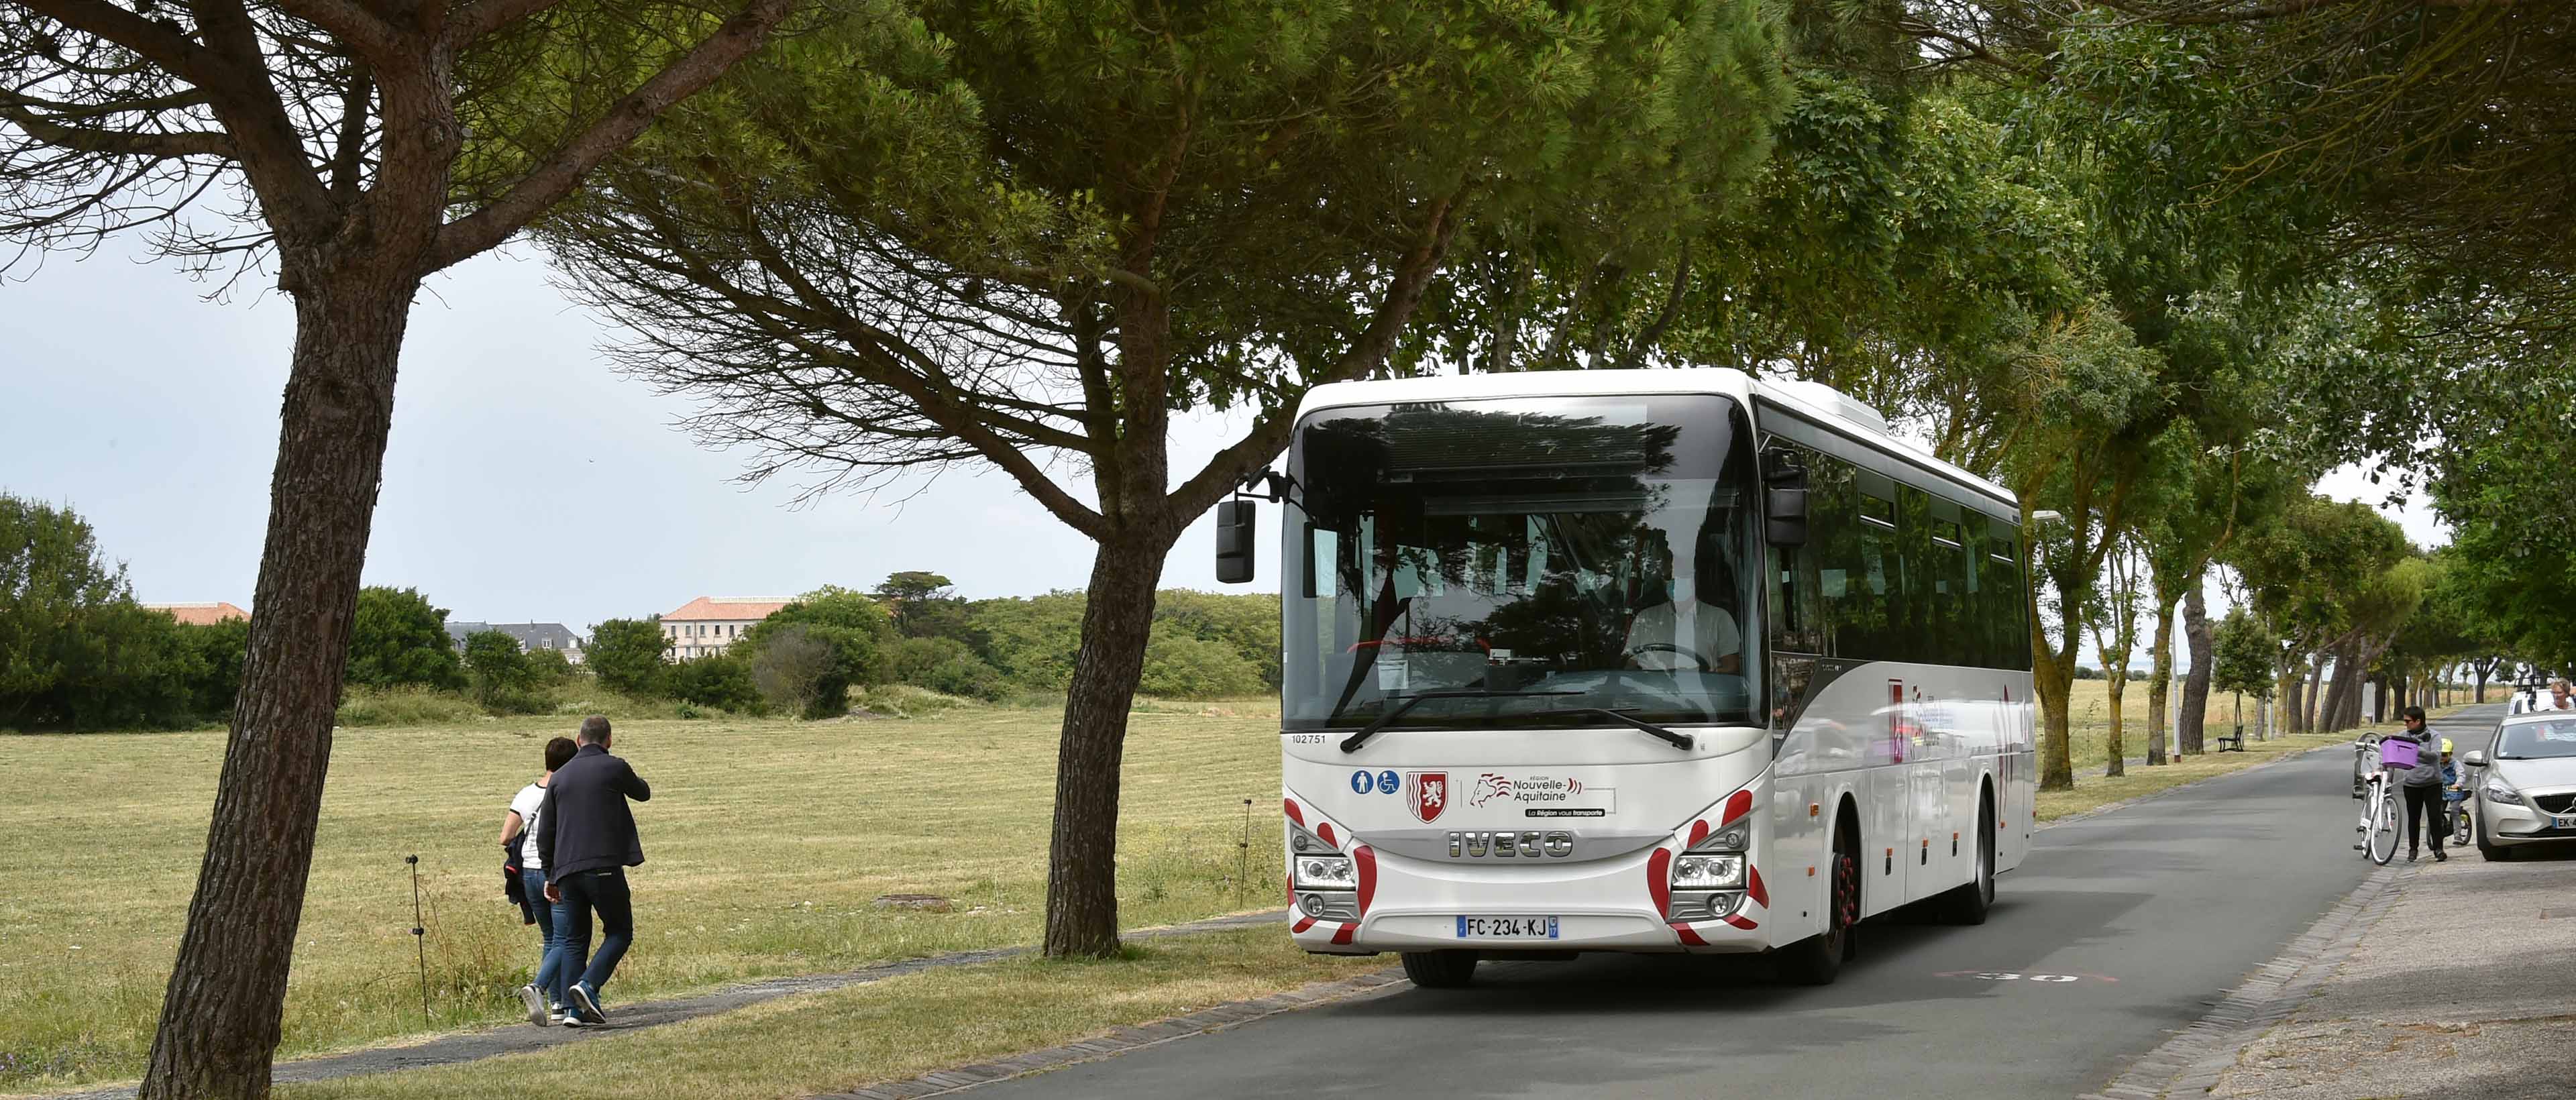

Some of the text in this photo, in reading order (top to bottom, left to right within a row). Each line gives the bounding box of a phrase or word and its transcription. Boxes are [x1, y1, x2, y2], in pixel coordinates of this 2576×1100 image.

[1292, 734, 1326, 744] 102751
[1513, 780, 1566, 790] Nouvelle-
[1514, 791, 1566, 804] Aquitaine
[1536, 808, 1557, 818] Région
[1572, 809, 1603, 818] transporte
[1449, 831, 1573, 857] IVECO
[1467, 919, 1546, 936] FC-234-KJ
[1550, 928, 1557, 936] 17
